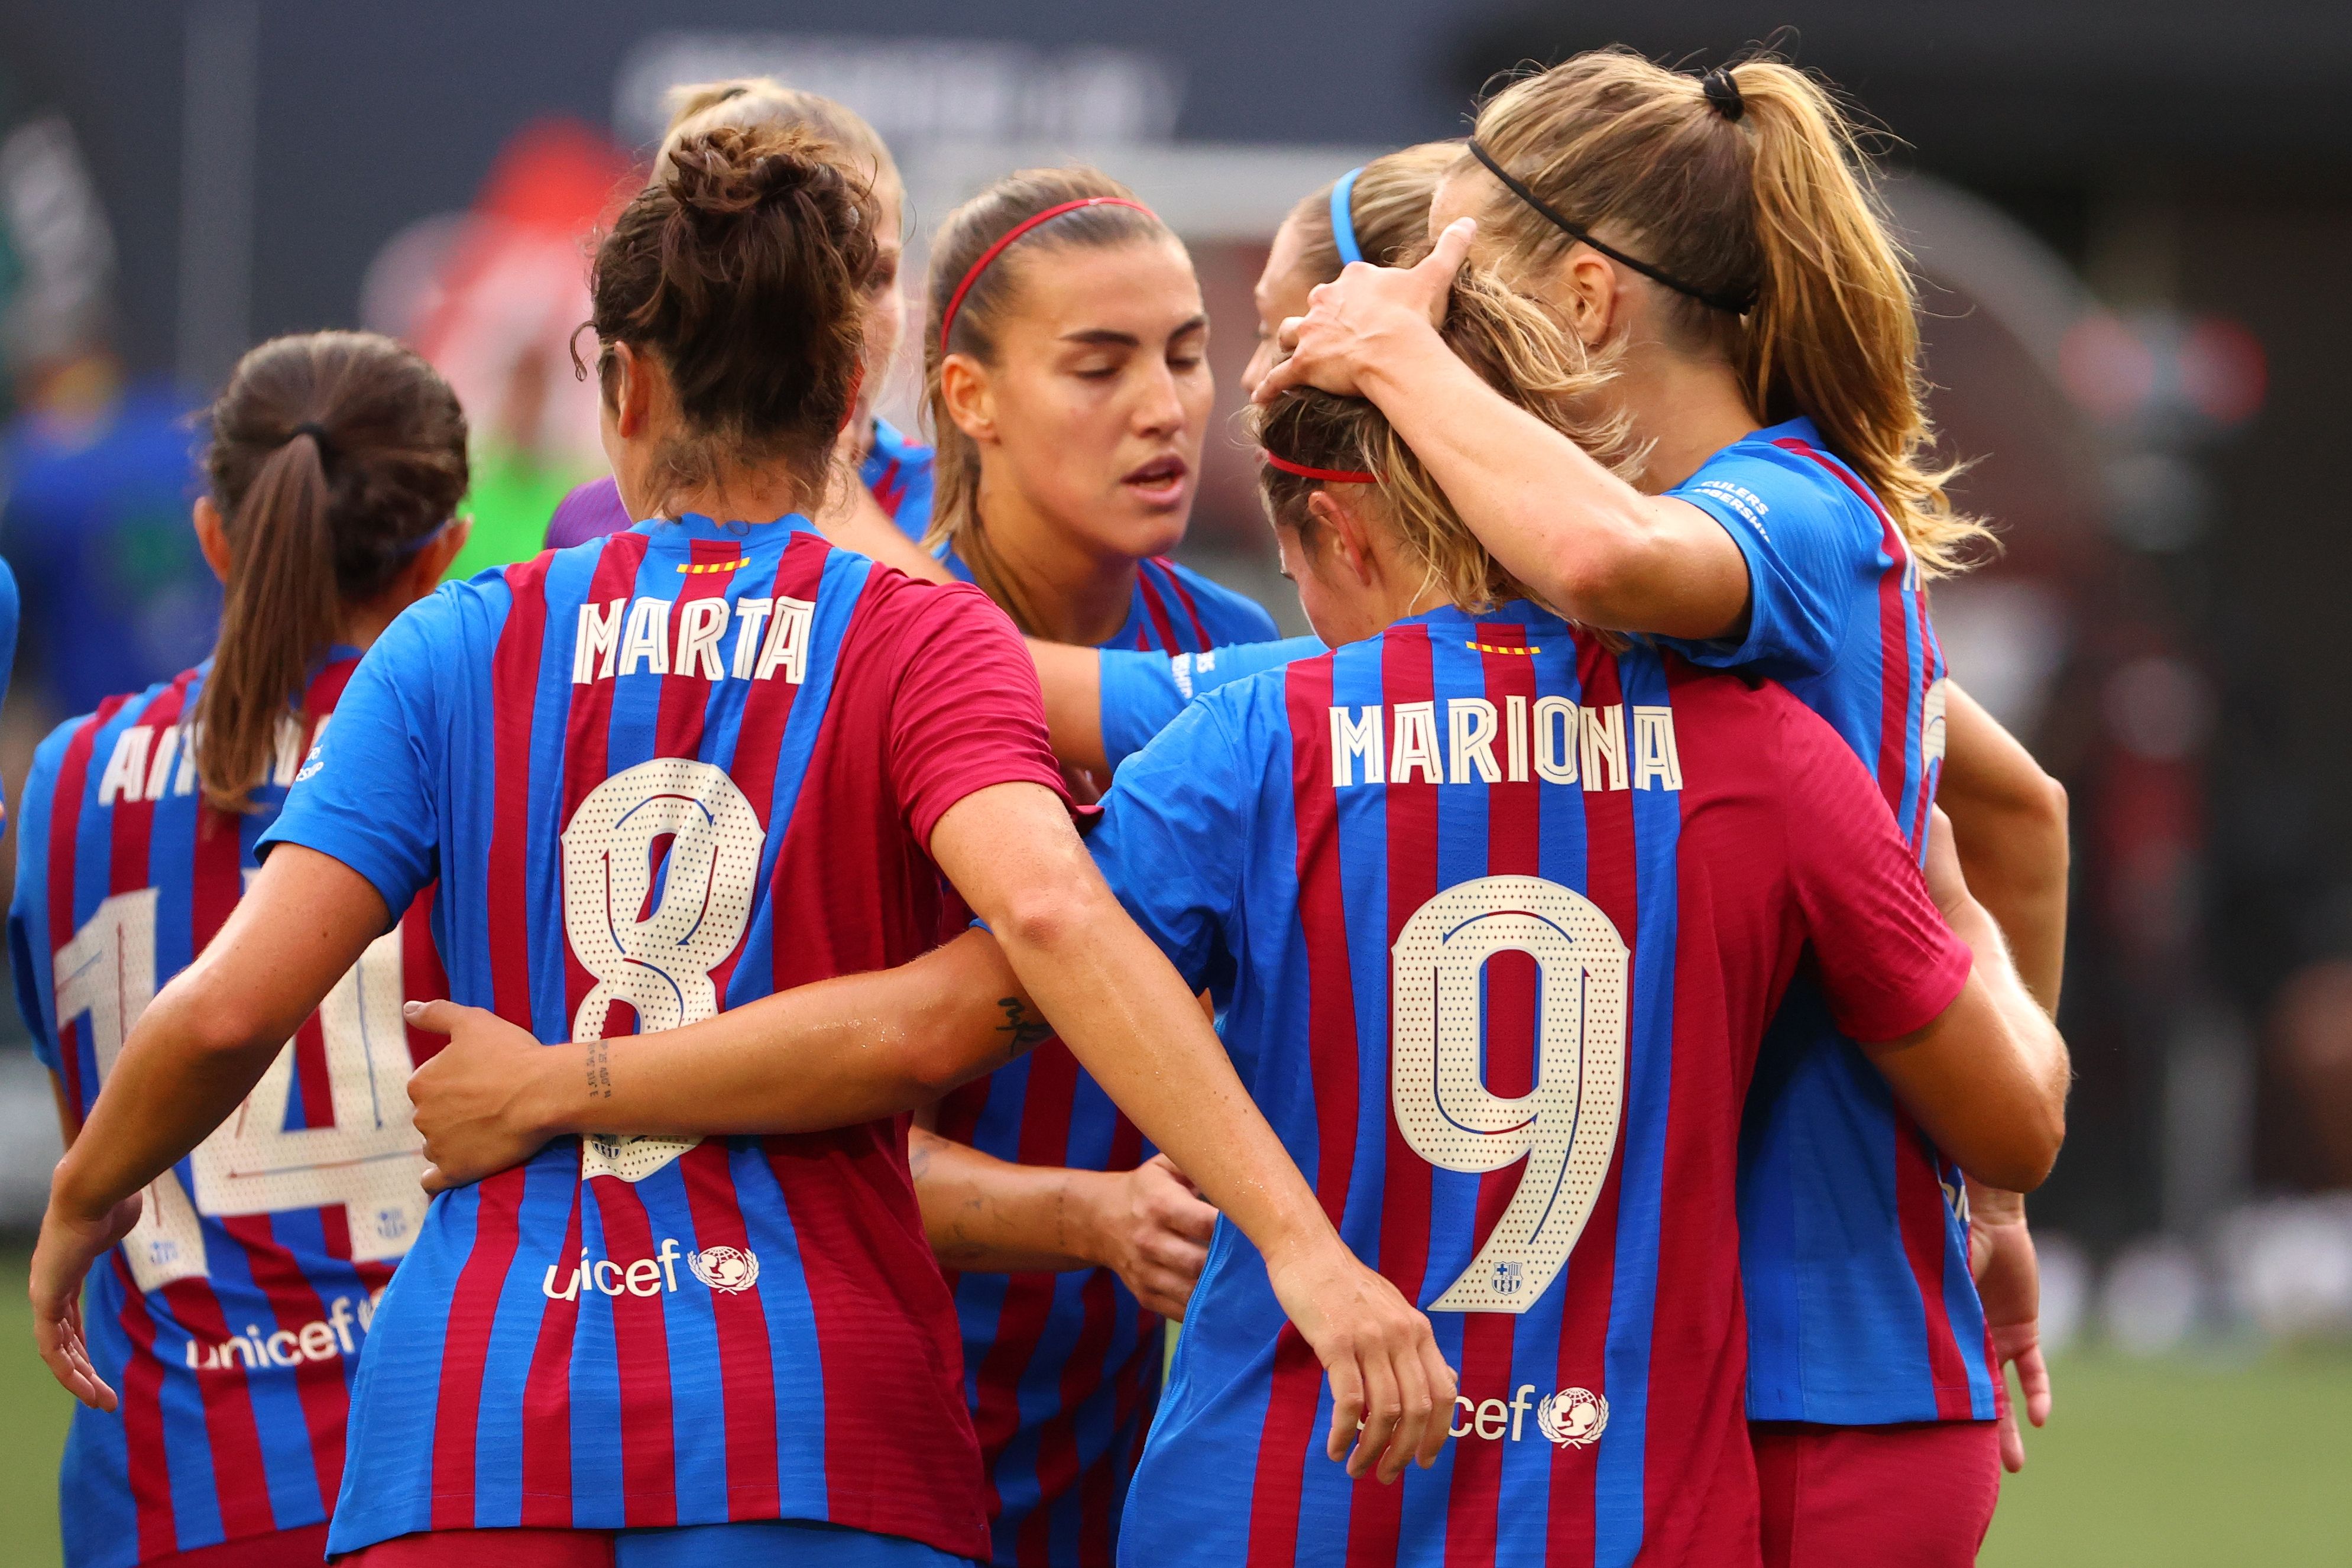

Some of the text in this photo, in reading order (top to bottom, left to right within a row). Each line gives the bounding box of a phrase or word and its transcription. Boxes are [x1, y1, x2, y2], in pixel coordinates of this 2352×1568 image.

[572, 596, 816, 685] MARTA
[1329, 695, 1683, 792] MARIONA
[561, 757, 766, 1183] 8
[53, 867, 428, 1294] 14
[1391, 874, 1631, 1313] 9
[542, 1238, 681, 1301] uicef
[185, 1295, 355, 1370] unicef
[1448, 1384, 1536, 1441] cef
